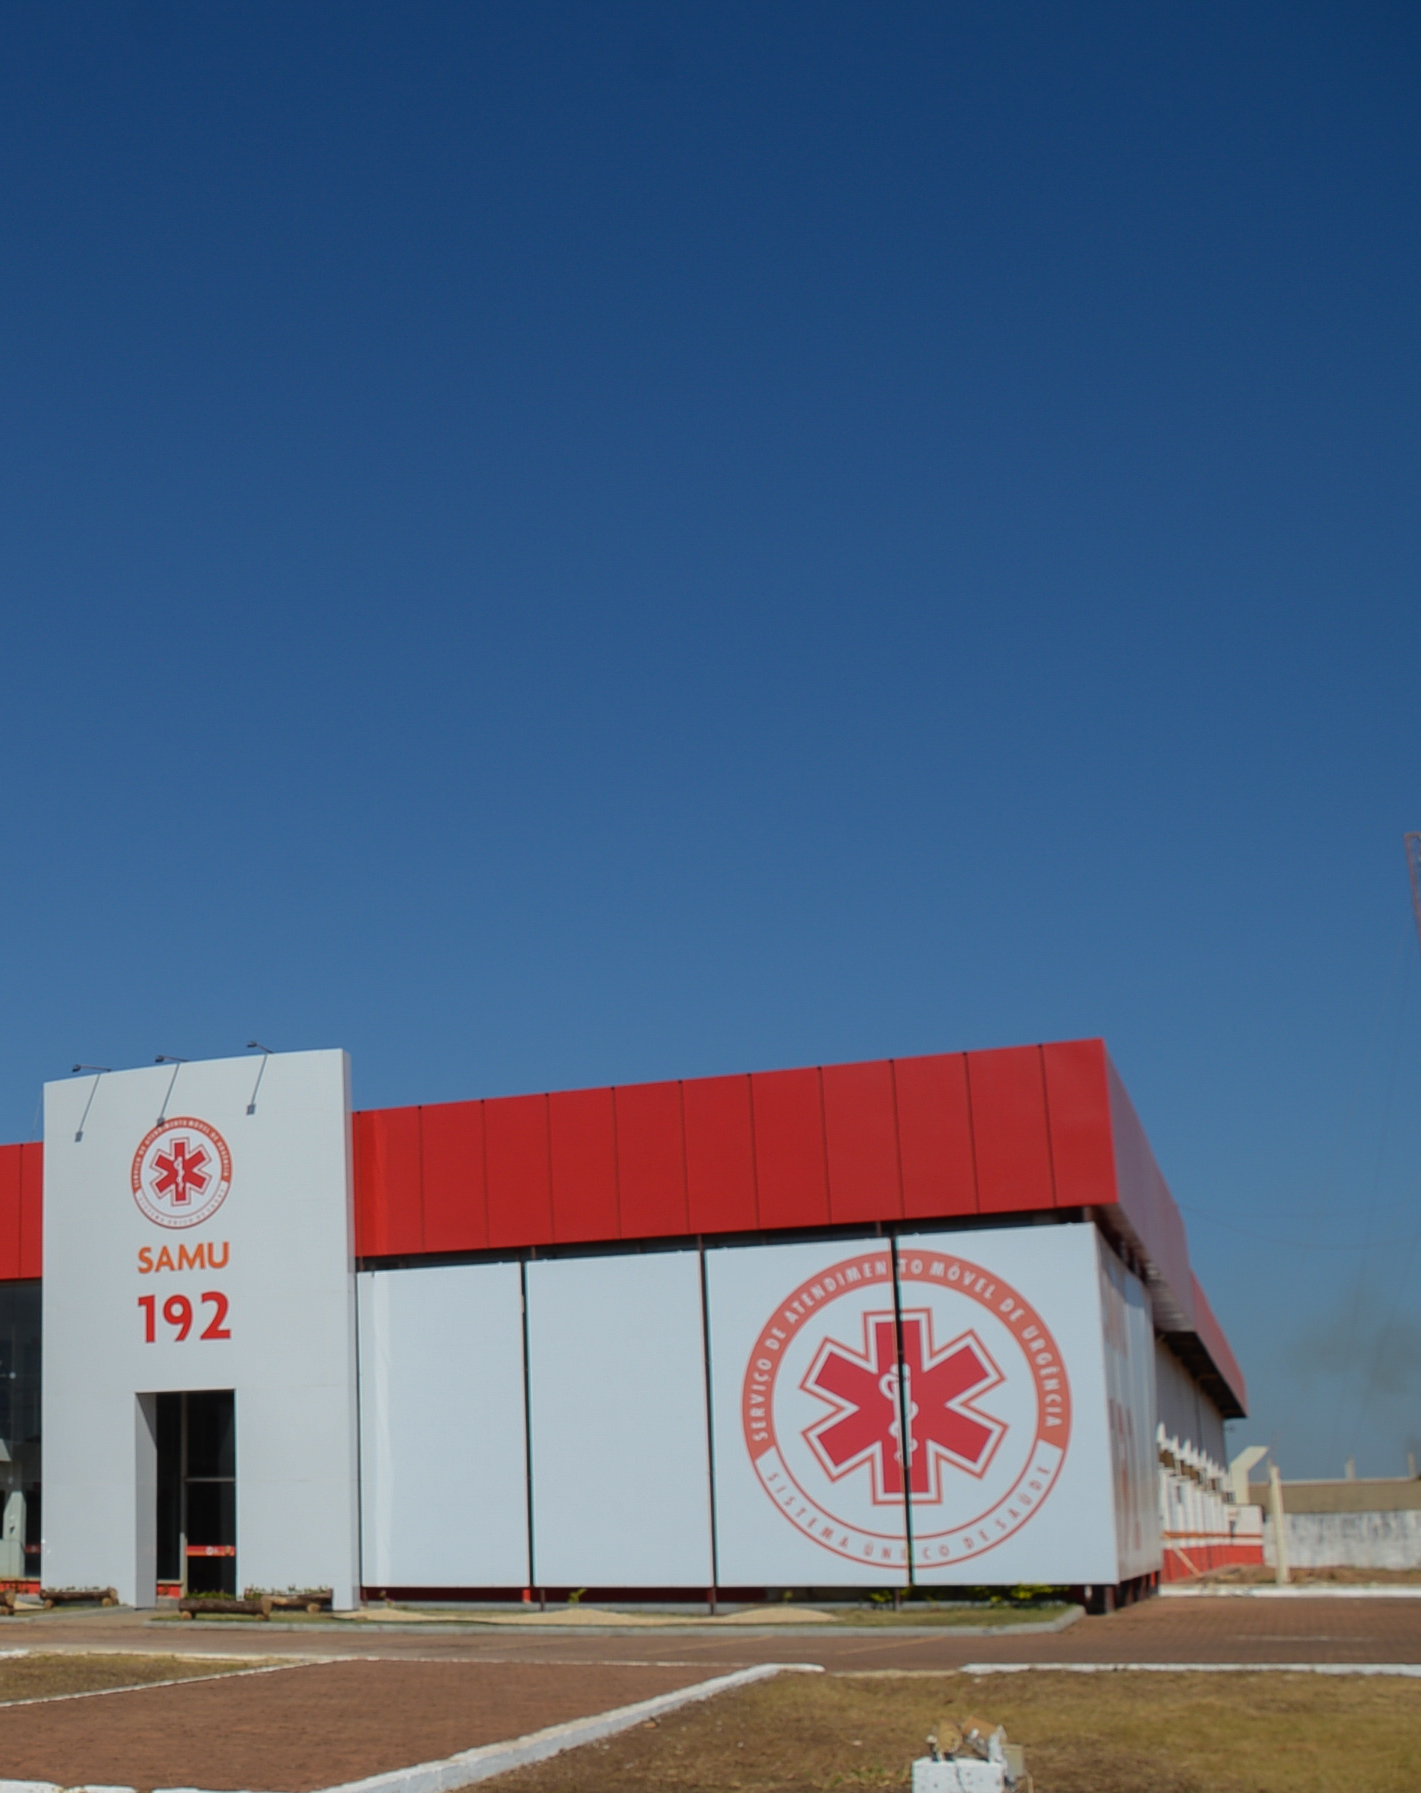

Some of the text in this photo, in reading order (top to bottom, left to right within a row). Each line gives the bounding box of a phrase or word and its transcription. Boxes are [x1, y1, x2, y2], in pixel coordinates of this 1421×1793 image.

[138, 1242, 229, 1274] SAMU
[138, 1291, 231, 1343] 192
[764, 1327, 787, 1351] DE
[784, 1258, 923, 1324] ATENDIMENTO
[930, 1260, 995, 1299] MÓVEL
[999, 1297, 1025, 1322] DE
